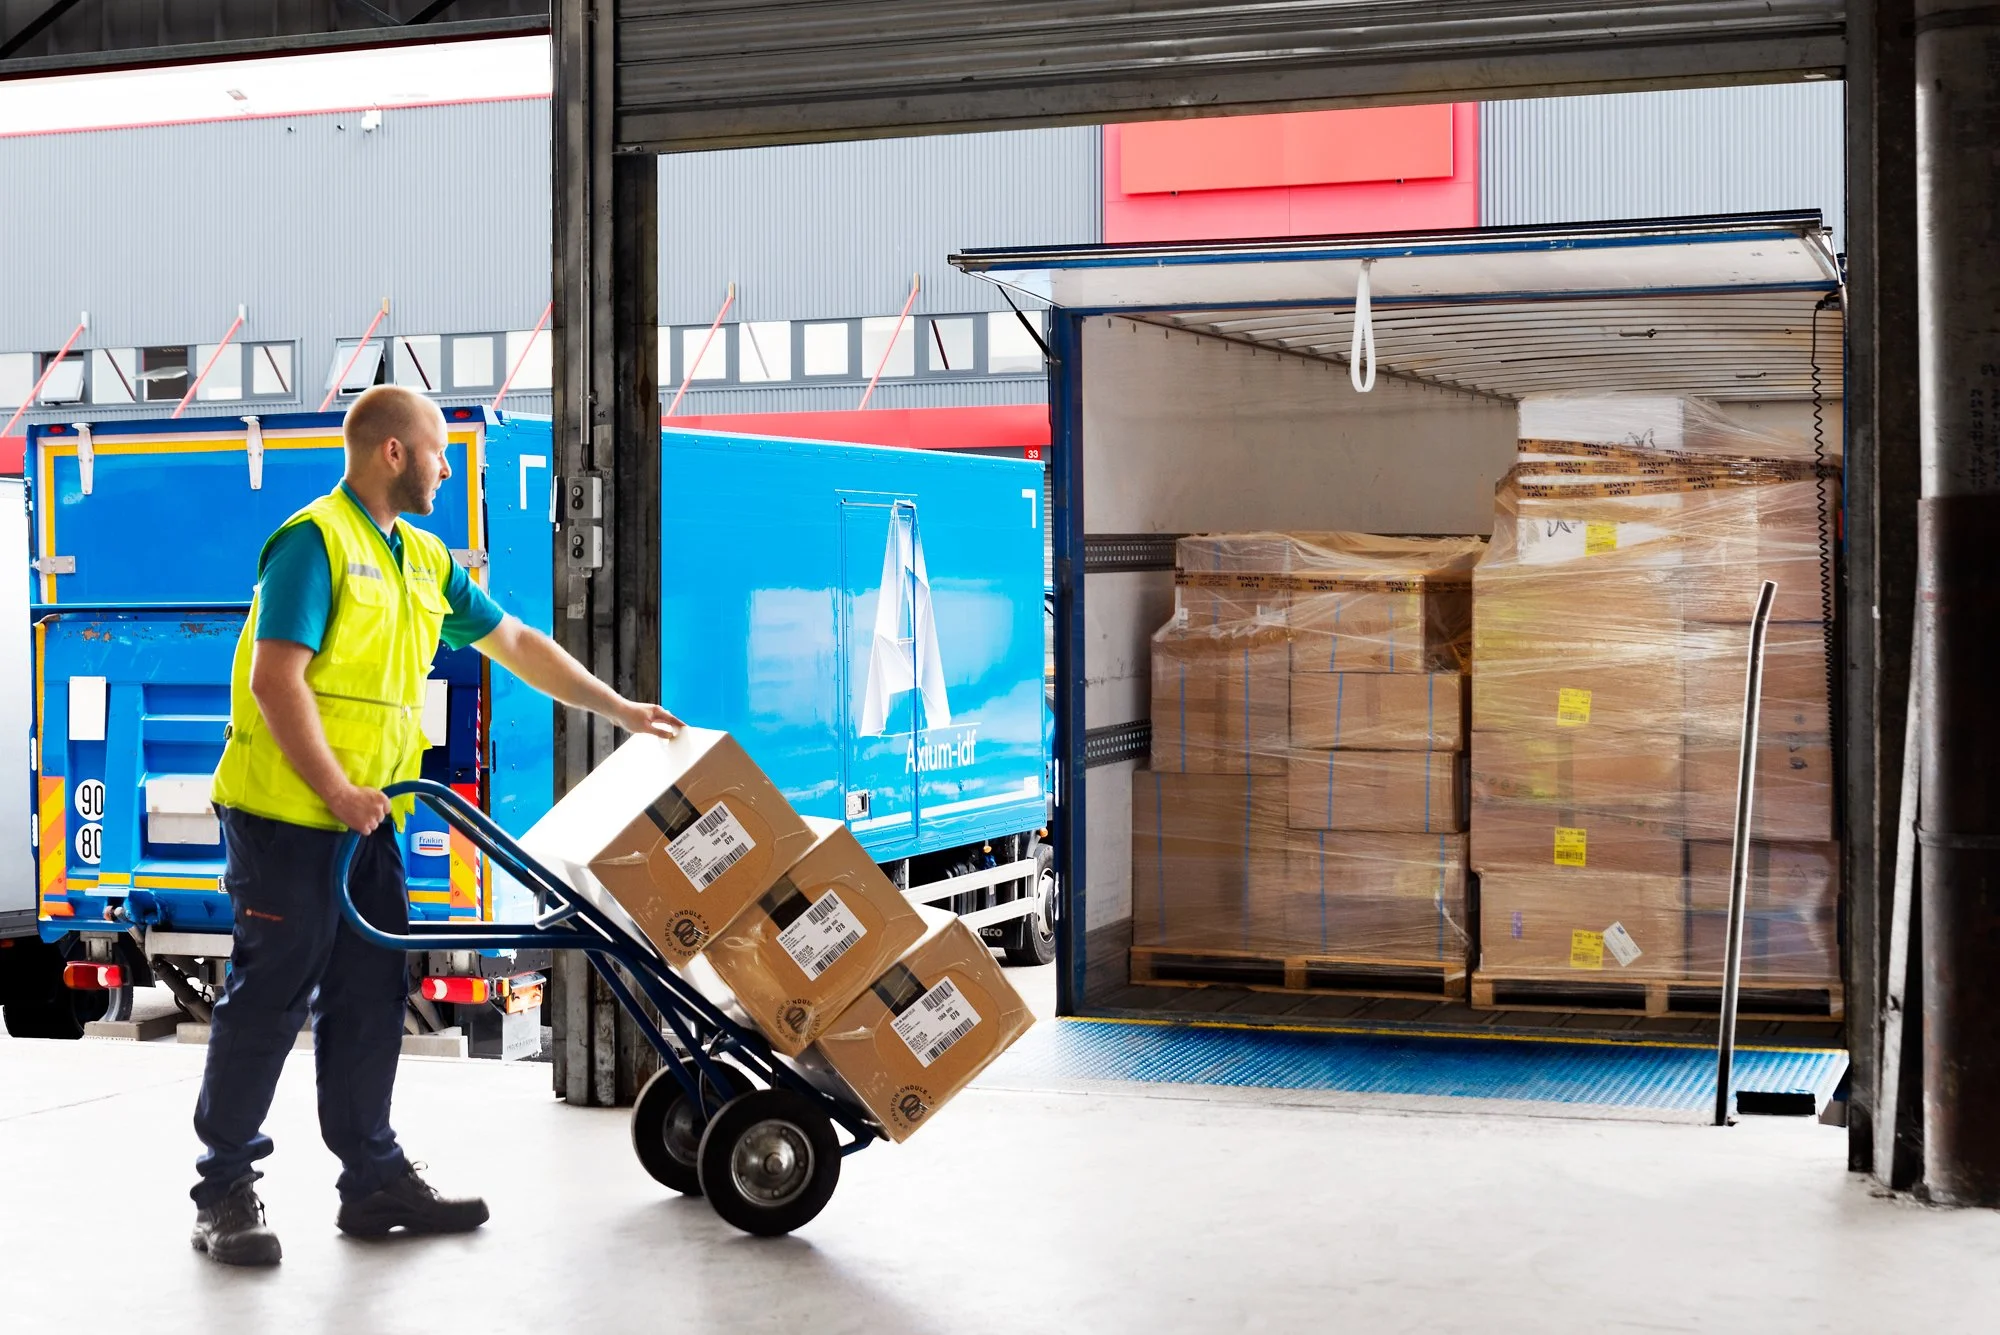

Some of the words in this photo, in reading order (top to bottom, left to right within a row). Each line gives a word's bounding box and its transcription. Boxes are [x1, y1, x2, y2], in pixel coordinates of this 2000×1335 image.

[1028, 450, 1038, 458] 33
[905, 729, 977, 774] Axium-idf
[82, 785, 104, 815] 90
[82, 828, 102, 859] 80
[419, 836, 443, 844] Fraikin
[978, 928, 1003, 937] ECO
